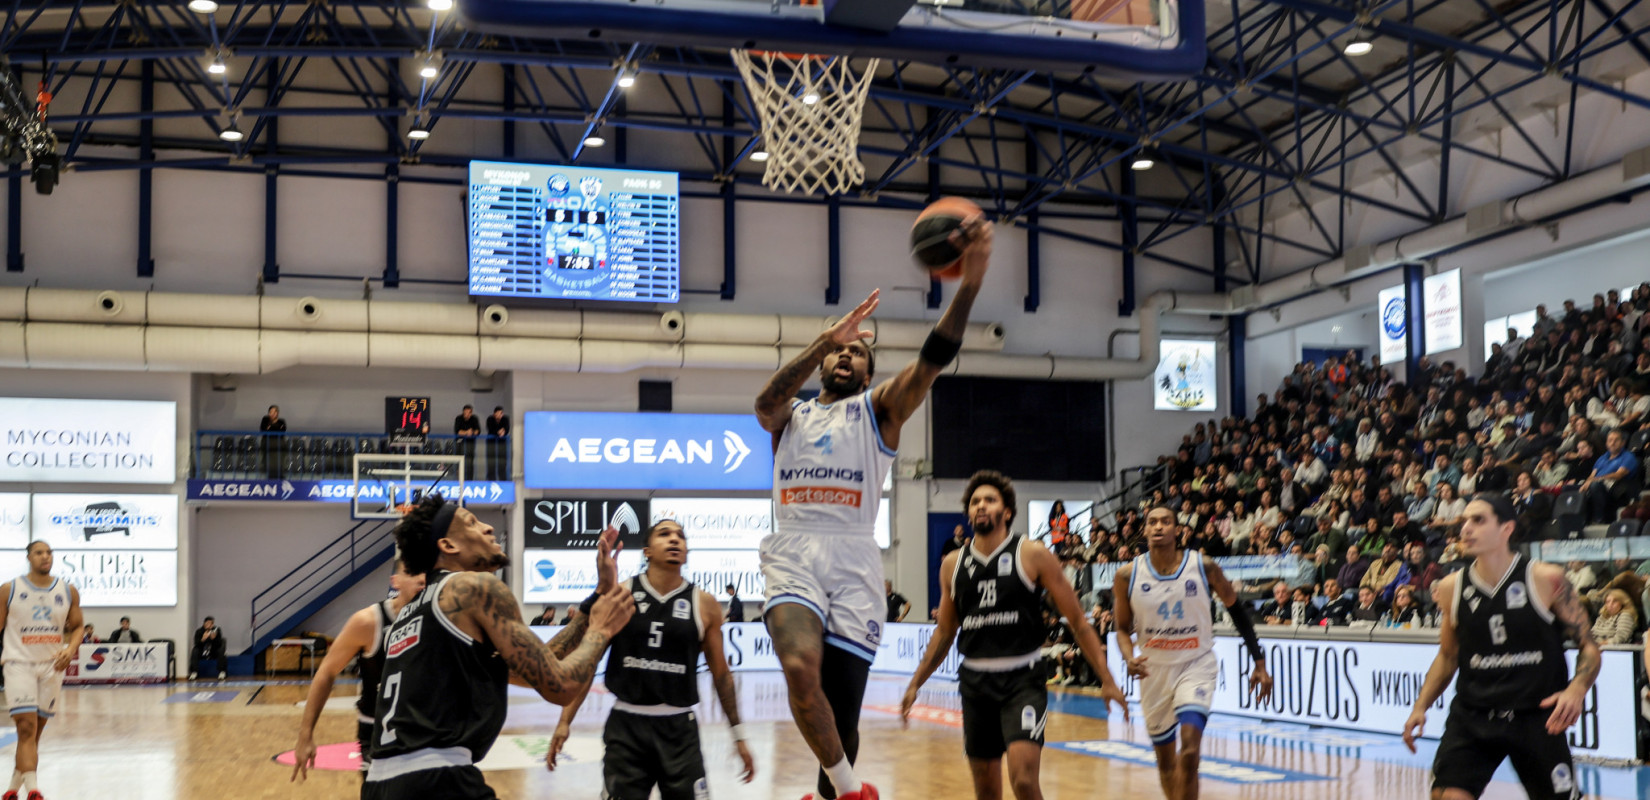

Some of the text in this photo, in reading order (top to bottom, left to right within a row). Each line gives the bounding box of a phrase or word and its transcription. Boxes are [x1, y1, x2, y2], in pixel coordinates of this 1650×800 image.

[402, 411, 421, 430] 14
[7, 429, 132, 447] MYCONIAN
[814, 428, 833, 456] 4
[6, 451, 154, 470] COLLECTION
[548, 437, 713, 465] AEGEAN
[780, 467, 864, 483] MYKONOS
[199, 483, 278, 497] AEGEAN
[308, 484, 384, 498] AEGEAN
[786, 487, 857, 506] betsson
[62, 554, 147, 575] SUPER
[977, 578, 998, 609] 28
[32, 604, 52, 621] 22
[1157, 600, 1185, 620] 44
[647, 620, 665, 648] 5
[1488, 613, 1508, 646] 6
[111, 646, 157, 663] SMK
[1238, 642, 1361, 723] BROUZOS
[379, 670, 403, 747] 2
